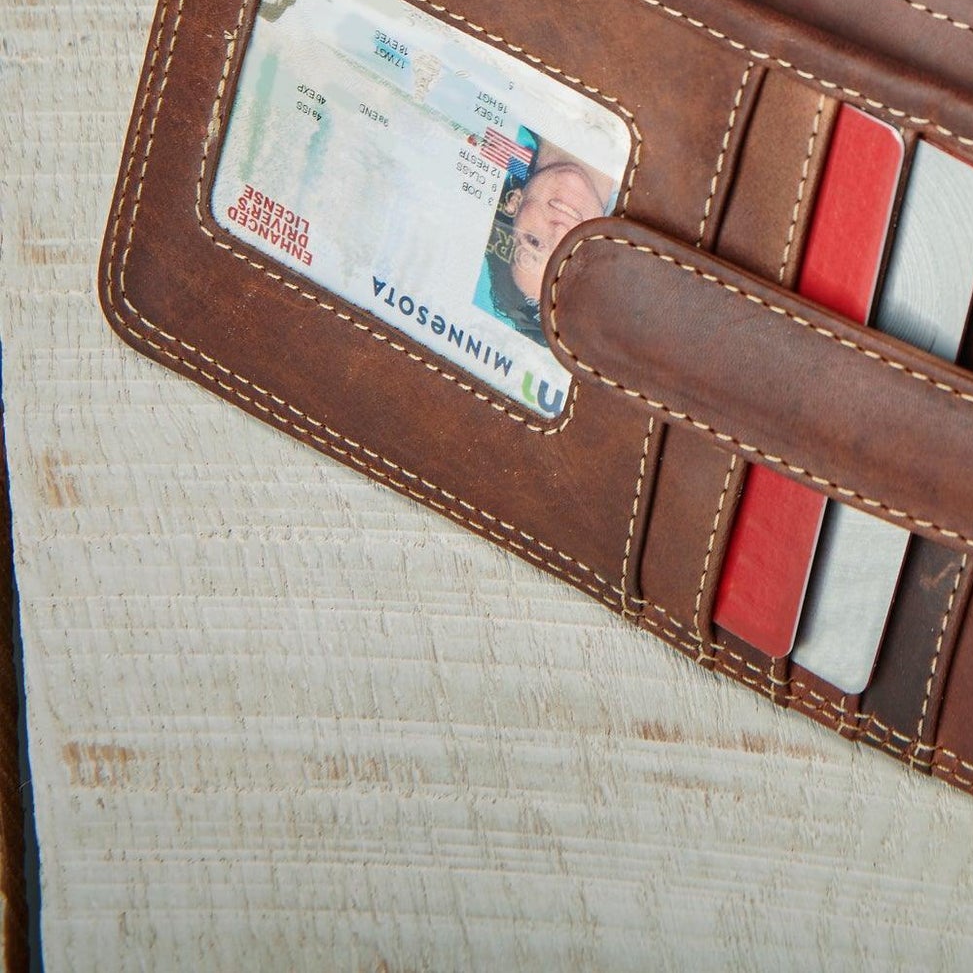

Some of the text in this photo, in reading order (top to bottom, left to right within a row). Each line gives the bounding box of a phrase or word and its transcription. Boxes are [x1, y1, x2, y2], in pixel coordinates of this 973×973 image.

[297, 84, 316, 99] EXP
[476, 91, 498, 110] HGT
[296, 100, 311, 116] ISS
[359, 103, 377, 121] END
[474, 103, 493, 122] SEX
[459, 148, 489, 172] RESTR
[456, 161, 486, 185] CLASS
[461, 181, 483, 200] DOB
[245, 184, 310, 234] LICENSE
[238, 197, 309, 249] DRIVER'S
[227, 205, 313, 266] ENHANCED
